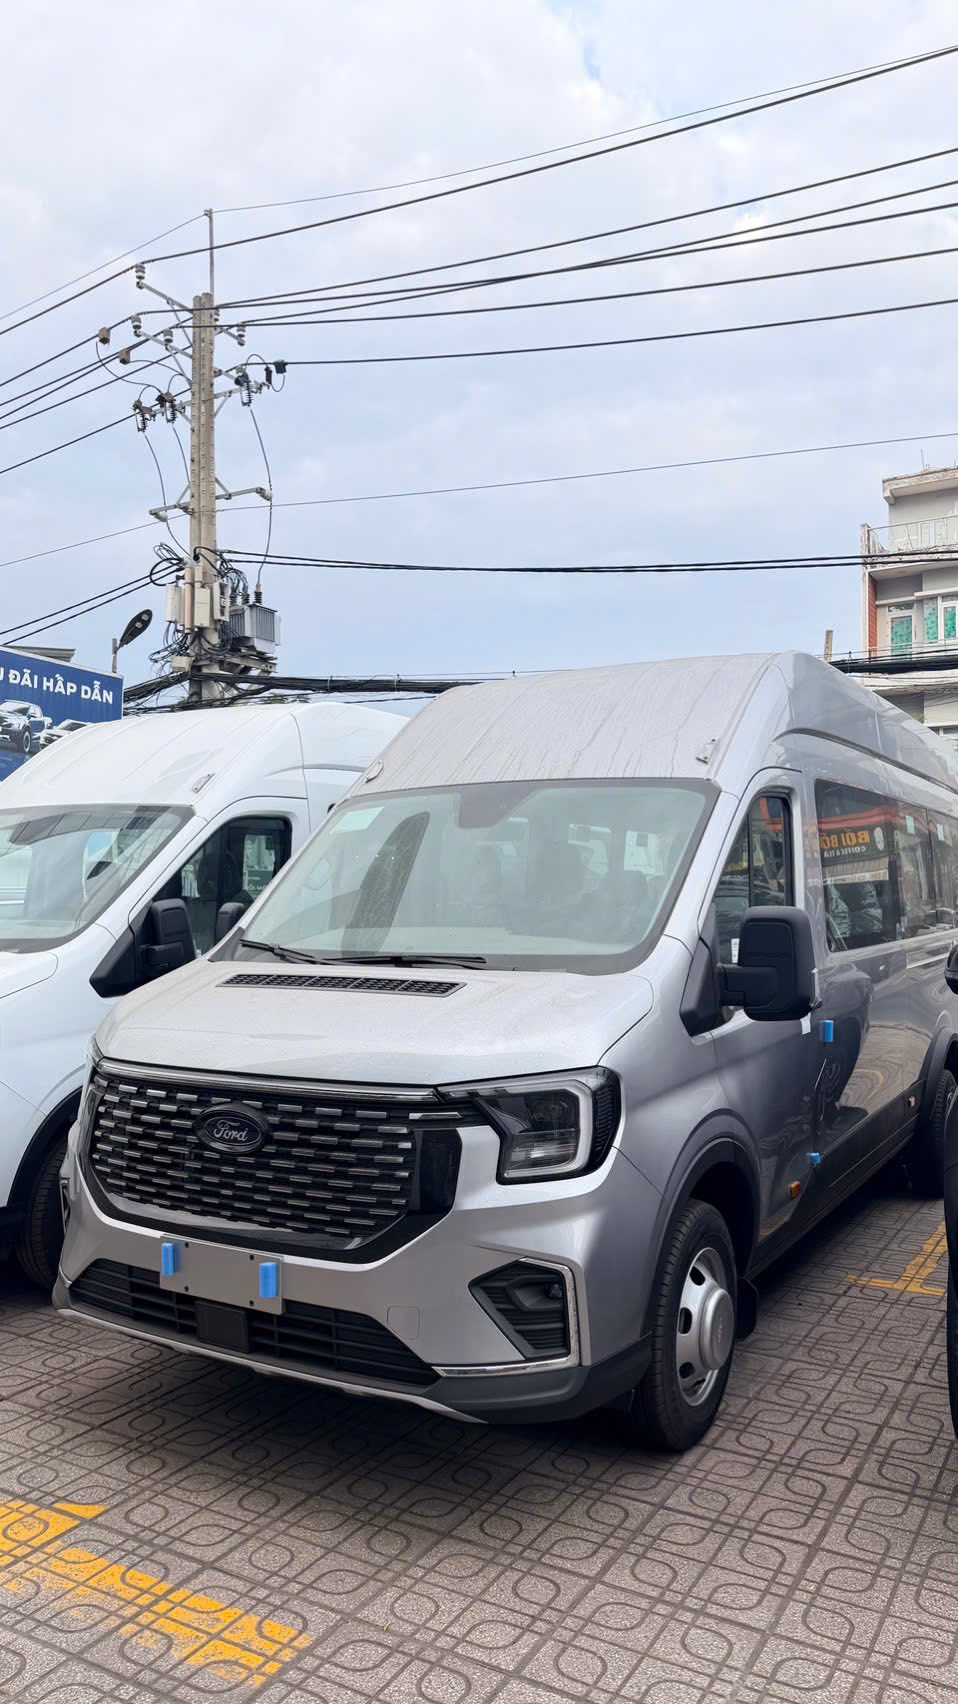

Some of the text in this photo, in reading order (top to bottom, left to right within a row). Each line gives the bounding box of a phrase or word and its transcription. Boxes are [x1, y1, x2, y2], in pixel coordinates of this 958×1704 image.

[8, 668, 38, 689] ĐÃI
[43, 674, 77, 695] HẤP
[81, 680, 113, 704] DẪN
[213, 1119, 248, 1141] Ford
